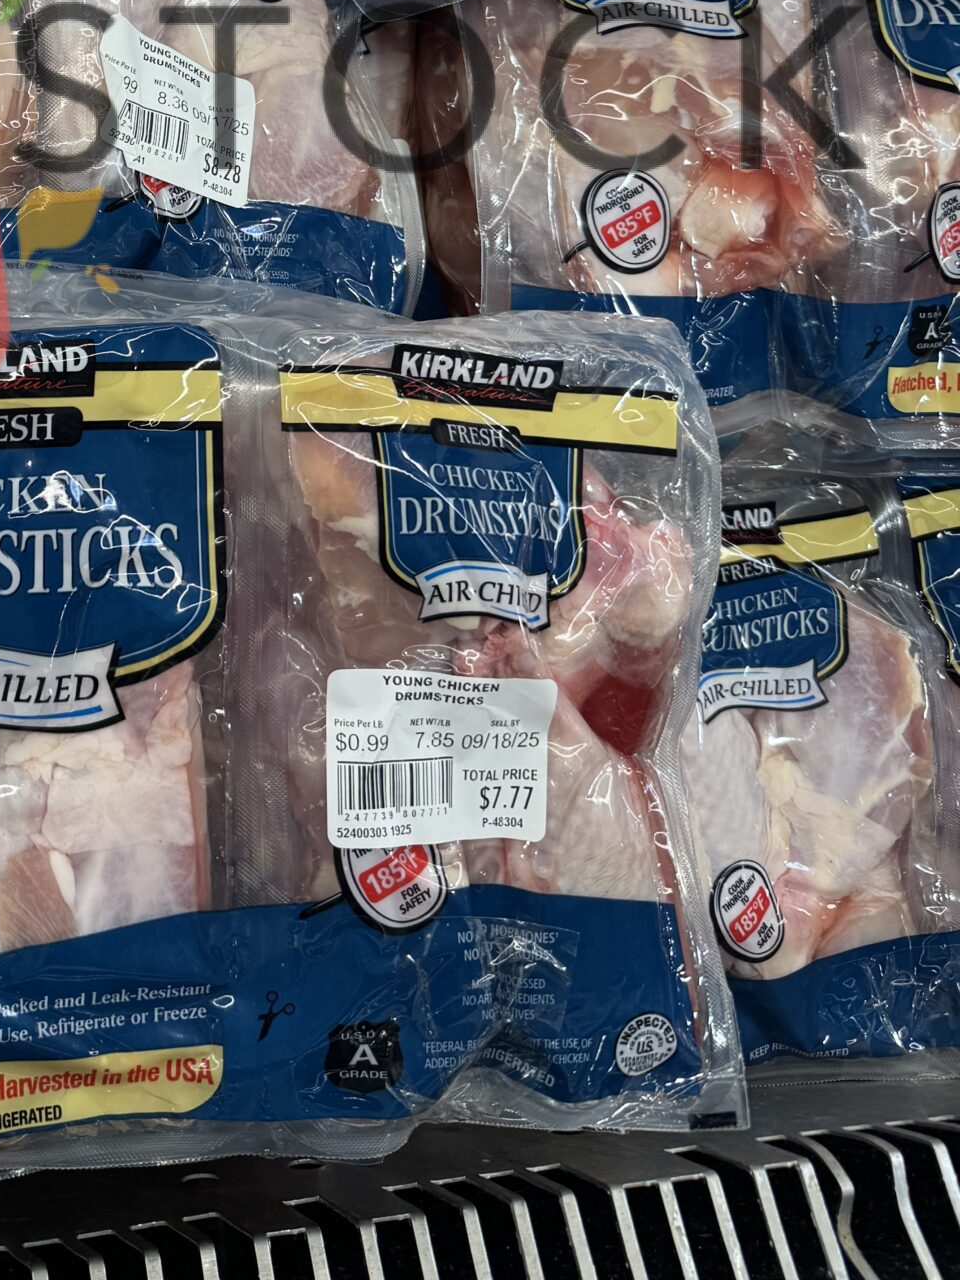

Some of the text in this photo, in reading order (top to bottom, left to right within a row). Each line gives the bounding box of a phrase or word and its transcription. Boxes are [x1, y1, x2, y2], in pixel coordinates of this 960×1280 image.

[601, 0, 731, 28] AIR-CHILLED
[139, 37, 211, 83] YOUNG CHICKEN
[142, 52, 202, 89] DRUMSTICKS
[157, 91, 250, 136] 8.36 09/17/25
[195, 133, 247, 163] TOTAL PRICE
[203, 152, 241, 184] $8.28
[202, 179, 233, 197] P-48304
[607, 206, 653, 242] 185°F
[631, 238, 657, 259] SAFETY
[633, 233, 649, 248] FOR
[400, 351, 556, 390] KIRKLAND
[446, 423, 507, 449] FRESH
[429, 462, 535, 493] CHICKEN
[399, 496, 562, 544] DRUMSTICKS
[383, 675, 500, 693] YOUNG CHICKEN
[703, 677, 812, 710] AIR-CHILLED
[395, 692, 484, 706] DRUMSTICKS
[334, 718, 520, 729] Price Per LB NET WT/LB SELL BY
[335, 731, 540, 753] $0.99 7.85 09/18/25
[462, 768, 538, 782] TOTAL PRICE
[479, 785, 534, 812] $7.77
[337, 824, 412, 838] 52400303 1925
[482, 817, 524, 828] P-48304
[399, 888, 433, 915] SAFETY
[401, 884, 422, 900] FOR
[734, 893, 765, 937] 185°F
[756, 923, 776, 949] SAFETY
[53, 992, 85, 1010] and
[91, 982, 212, 1006] Leak-Resistant
[37, 1011, 126, 1039] Refrigerate
[130, 1011, 148, 1025] or
[154, 1005, 207, 1024] Freeze
[618, 1014, 676, 1047] INSPECTED
[350, 1043, 379, 1066] A
[101, 1068, 121, 1086] in
[127, 1064, 160, 1083] the
[165, 1057, 214, 1086] USA
[339, 1069, 389, 1080] GRADE
